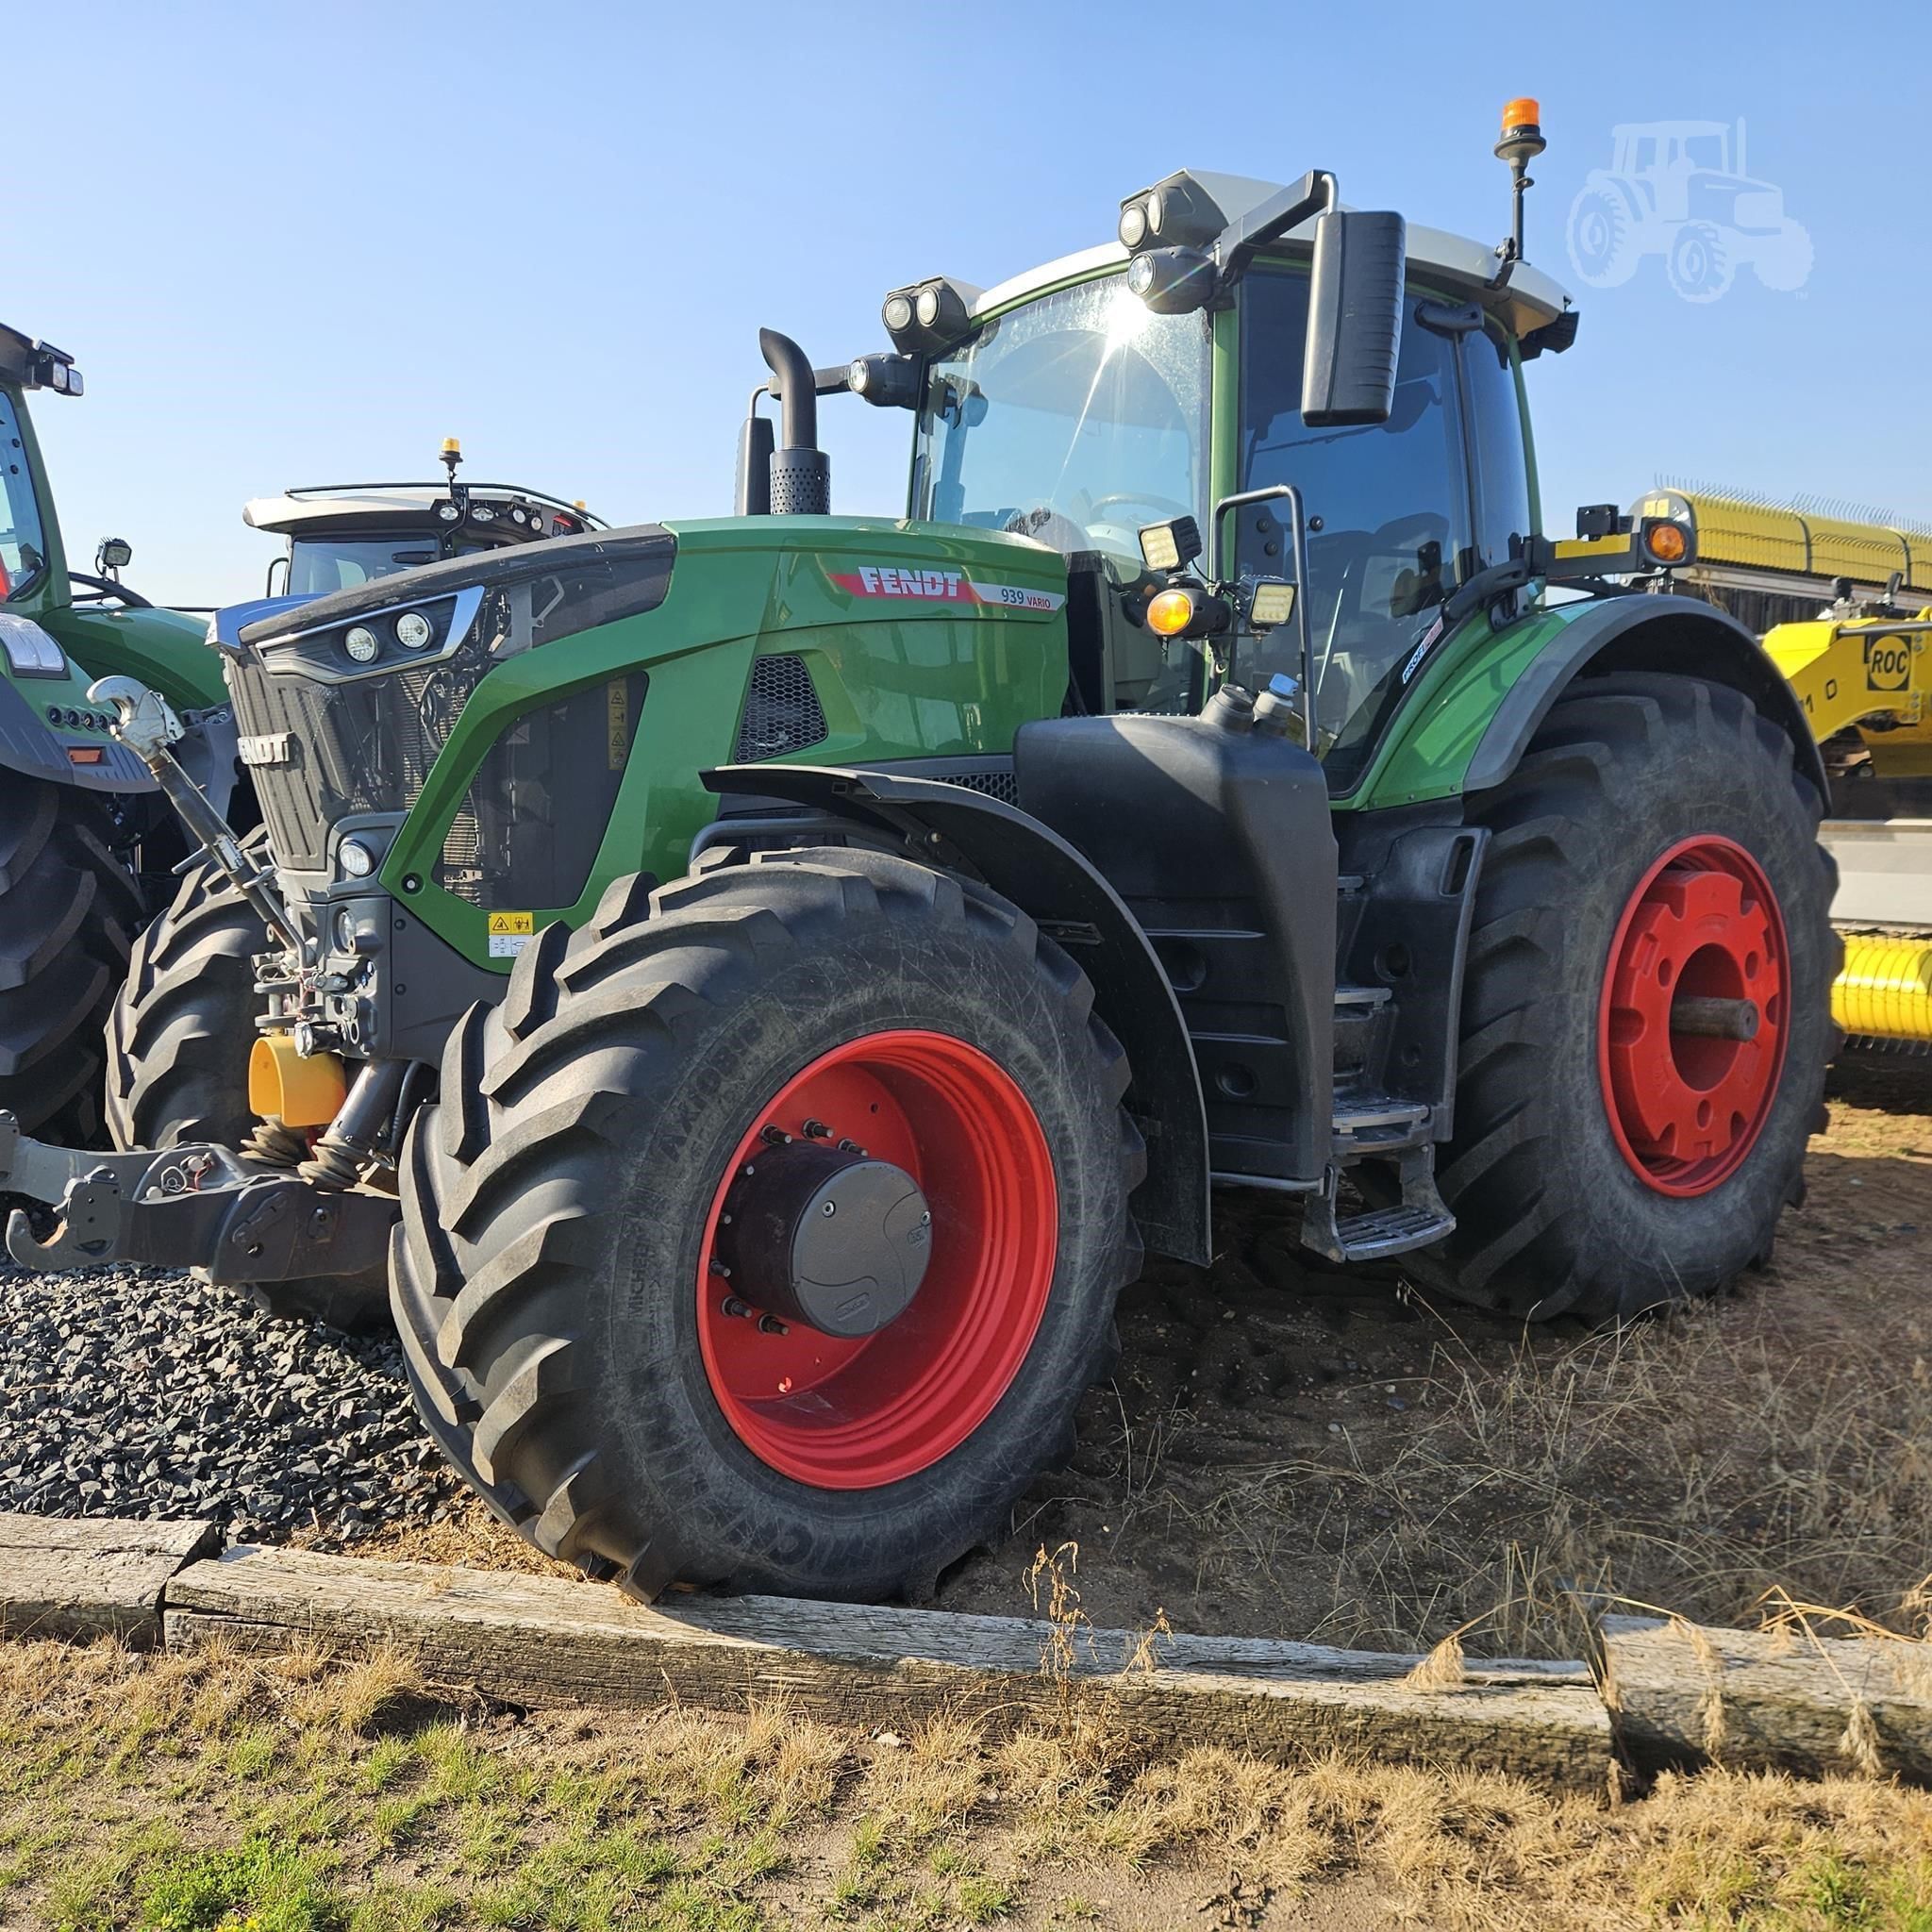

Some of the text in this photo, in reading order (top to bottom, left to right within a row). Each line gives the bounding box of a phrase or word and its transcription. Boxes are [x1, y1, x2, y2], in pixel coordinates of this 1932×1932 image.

[858, 566, 1051, 609] FENDT 939 VARIO
[1872, 650, 1907, 674] ROC
[238, 734, 290, 765] ENDT
